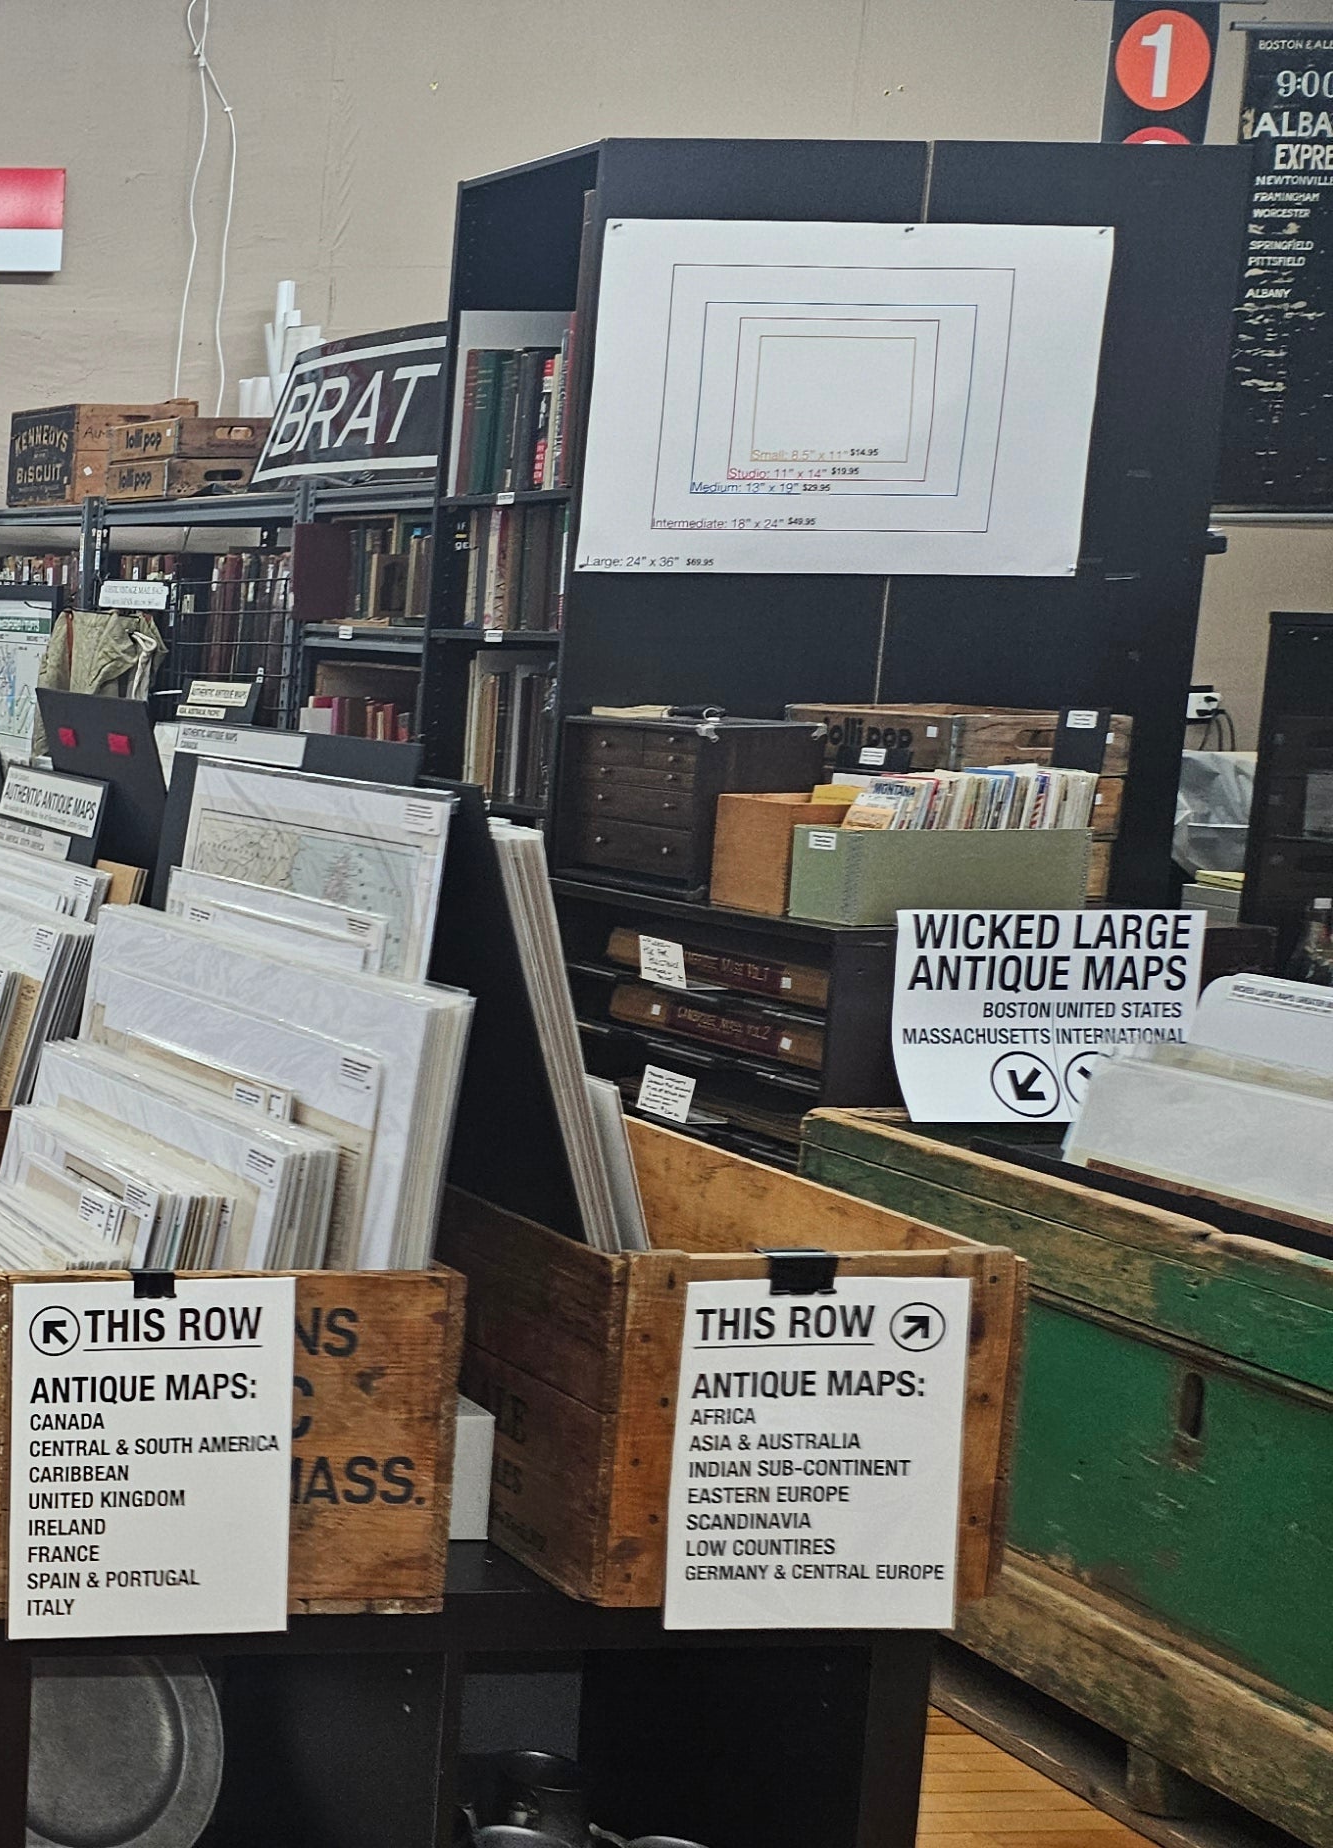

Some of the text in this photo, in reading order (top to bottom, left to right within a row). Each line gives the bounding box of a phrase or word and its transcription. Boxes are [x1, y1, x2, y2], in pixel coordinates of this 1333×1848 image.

[1141, 24, 1173, 98] 1
[1253, 192, 1321, 202] FRAMINGHAM
[1252, 208, 1310, 218] WORCESTER
[1249, 239, 1314, 250] SPRINGFIELD
[1247, 256, 1306, 267] PITTSFIELD
[1244, 288, 1292, 299] ALBANY
[269, 363, 442, 457] BRAT
[14, 425, 69, 456] KENNEDYS
[730, 468, 769, 479] Studio:
[692, 482, 742, 493] Medium:
[653, 518, 728, 529] Intermediate:
[788, 517, 816, 526] $49.95
[586, 556, 623, 568] Large:
[686, 558, 714, 566] $69.95
[872, 783, 916, 798] MONTANA
[914, 914, 1191, 949] WICKED LARGE
[907, 955, 1187, 993] ANTIQUE MAPS
[983, 1002, 1182, 1018] BOSTON UNITED STATES
[902, 1028, 1186, 1044] MASSACHUSETTS INTERNATIONAL
[84, 1307, 263, 1342] THIS ROW
[697, 1306, 875, 1340] THIS ROW
[30, 1373, 256, 1405] ANTIQUE MAPS:
[692, 1371, 924, 1400] ANTIQUE MAPS:
[30, 1413, 105, 1430] CANADA
[690, 1408, 756, 1425] AFRICA
[30, 1436, 279, 1457] CENTRAL & SOUTH AMERICA
[690, 1433, 861, 1451] ASIA & AUSTRALIA
[30, 1466, 129, 1482] CARIBBEAN
[689, 1460, 910, 1477] INDIAN SUB-CONTINENT
[29, 1490, 184, 1509] UNITED KINGDOM
[688, 1486, 849, 1503] EASTERN EUROPE
[29, 1519, 106, 1536] IRELAND
[686, 1514, 811, 1530] SCANDINAVIA
[28, 1546, 100, 1563] FRANCE
[686, 1539, 835, 1556] LOW COUNTIRES
[27, 1570, 200, 1589] SPAIN & PORTUGAL
[685, 1564, 944, 1580] GERMANY & CENTRAL EUROPE
[27, 1599, 75, 1616] ITALY
